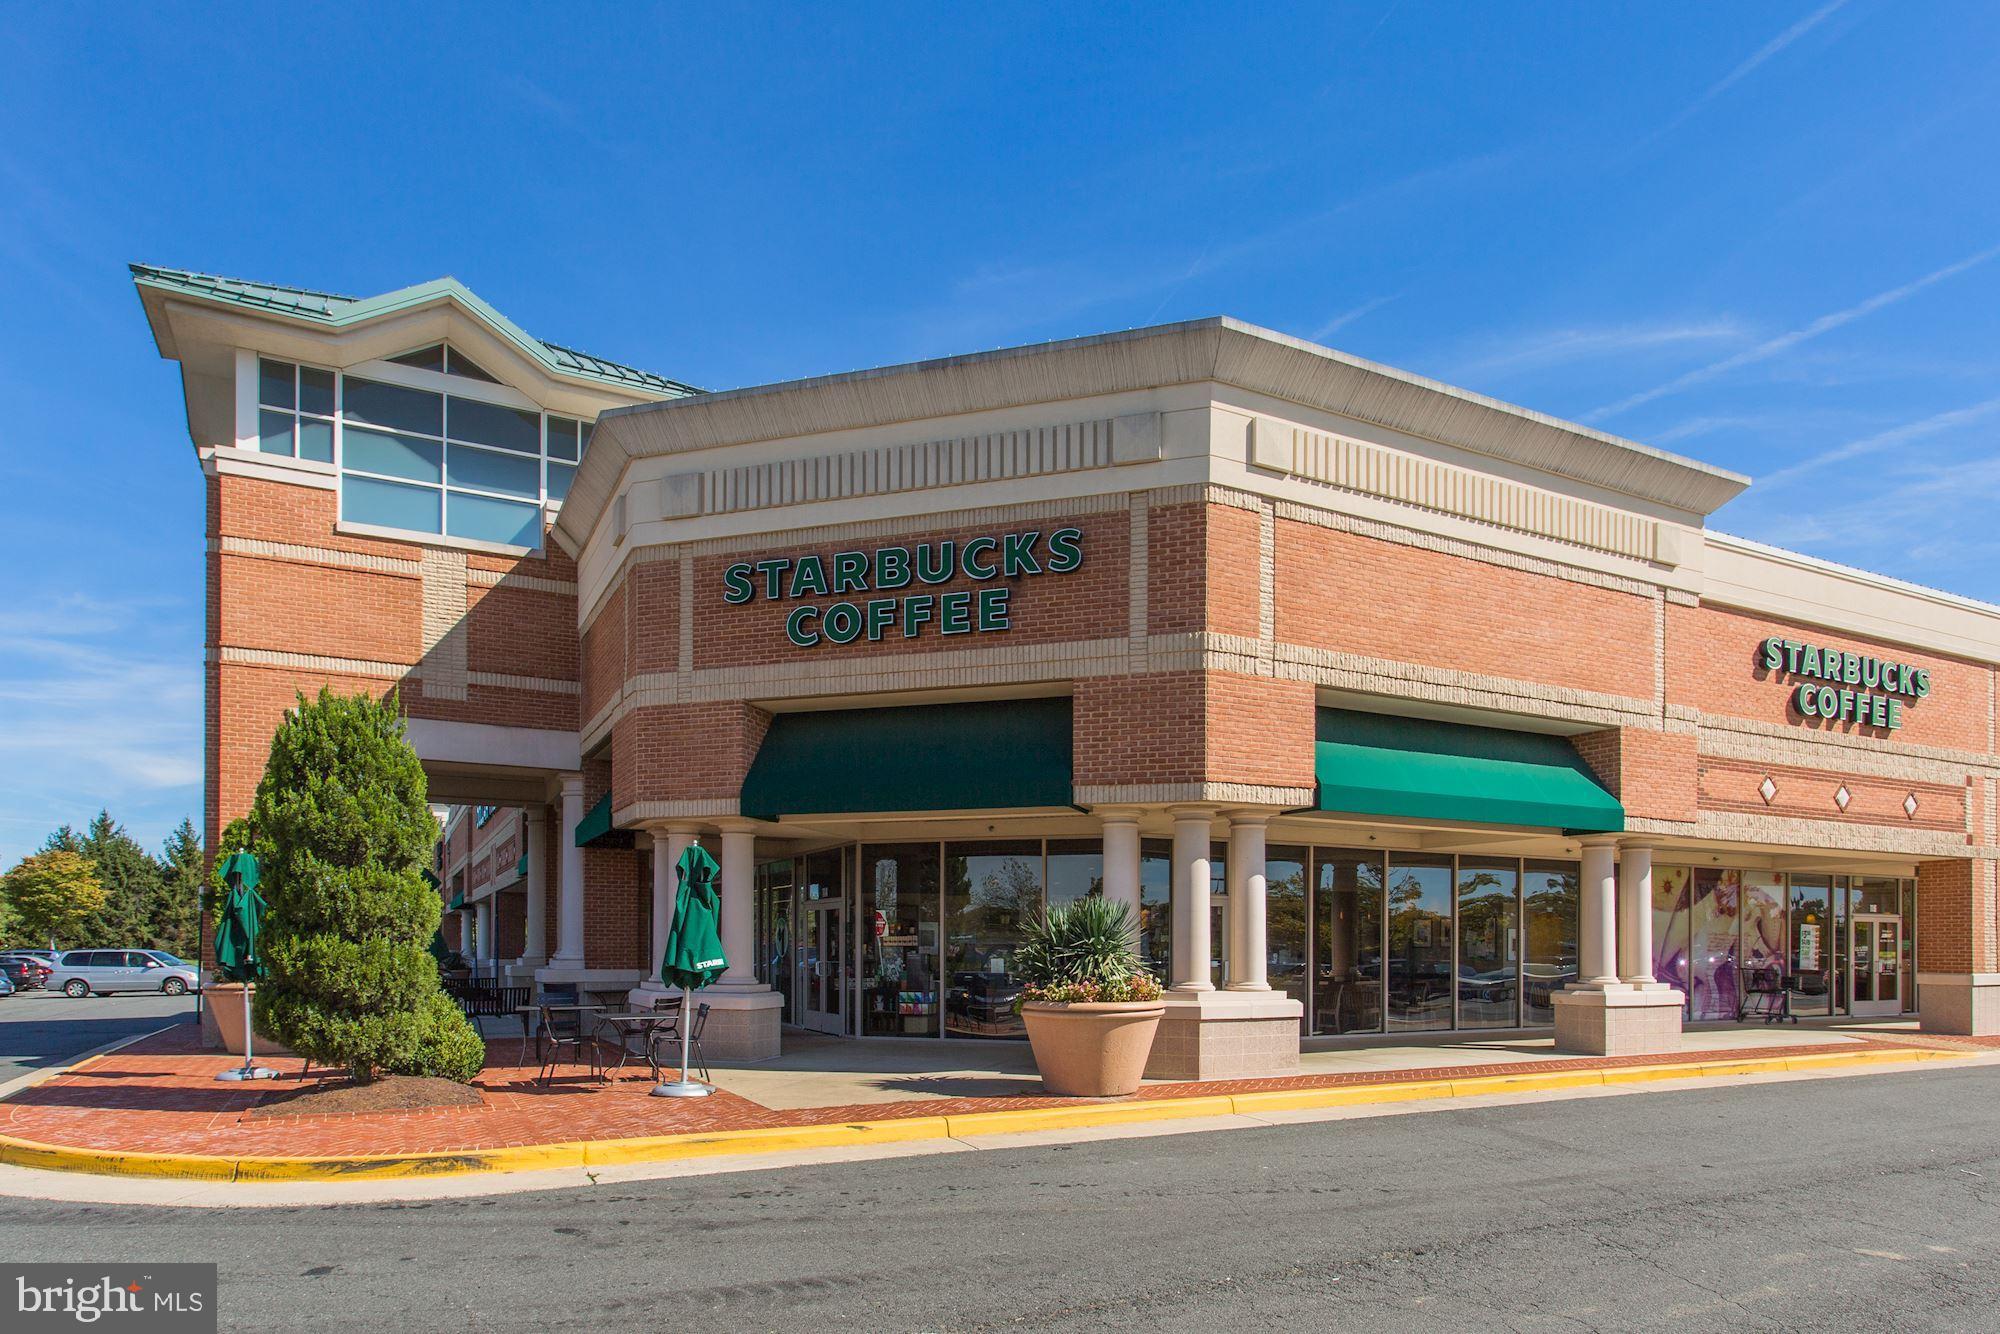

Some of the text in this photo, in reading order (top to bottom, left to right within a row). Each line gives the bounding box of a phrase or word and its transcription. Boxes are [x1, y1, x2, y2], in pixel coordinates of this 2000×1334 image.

[724, 528, 1083, 604] STARBUCKS
[786, 587, 1011, 647] COFFEE
[1765, 636, 1931, 698] STARBUCKS
[1798, 683, 1903, 730] COFFEE
